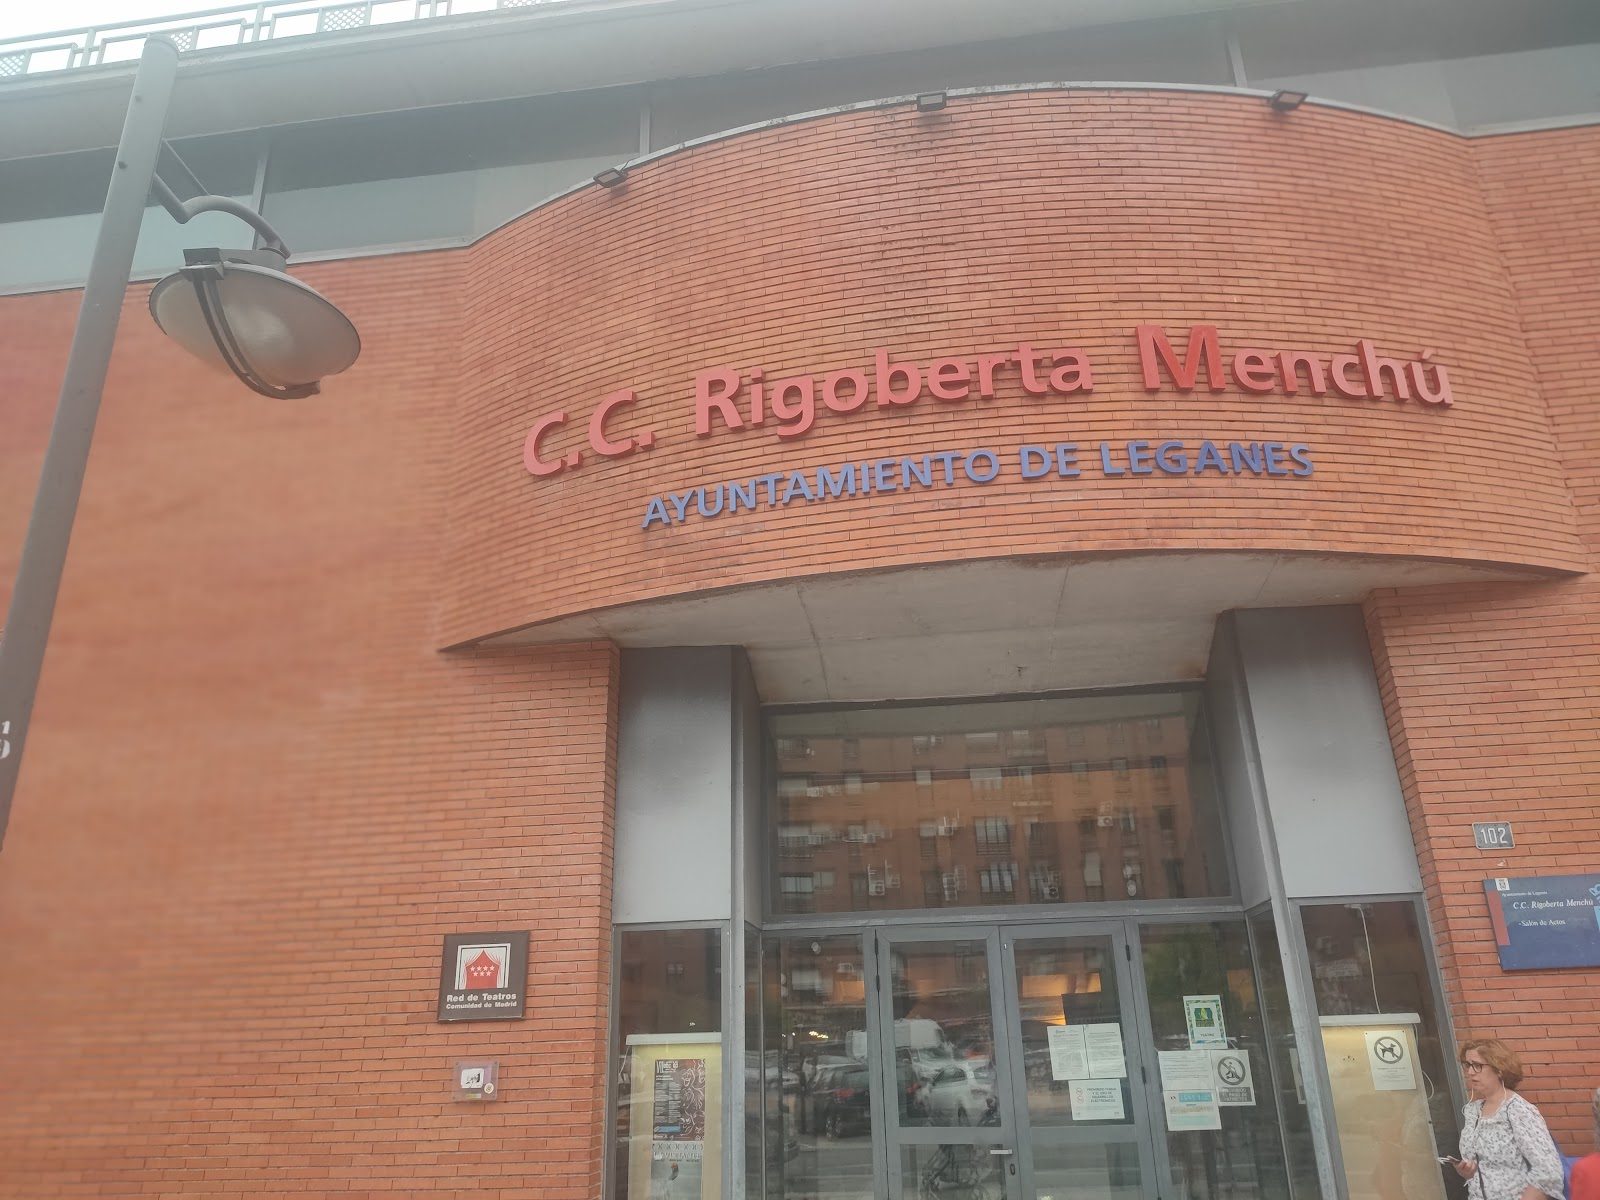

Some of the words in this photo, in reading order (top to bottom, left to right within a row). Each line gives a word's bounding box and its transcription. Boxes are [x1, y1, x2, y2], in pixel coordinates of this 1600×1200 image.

[522, 391, 655, 478] C.C.
[694, 341, 1094, 438] Rigoberta
[1135, 324, 1453, 408] Menchú
[641, 449, 1000, 529] AYUNTAMIENTO
[1019, 443, 1081, 482] DE
[1100, 441, 1315, 478] LEGANES
[1480, 827, 1508, 845] 102
[1531, 899, 1564, 910] Rigoberta
[446, 994, 465, 1002] Red
[467, 994, 479, 1002] de
[482, 993, 517, 1001] Teatros
